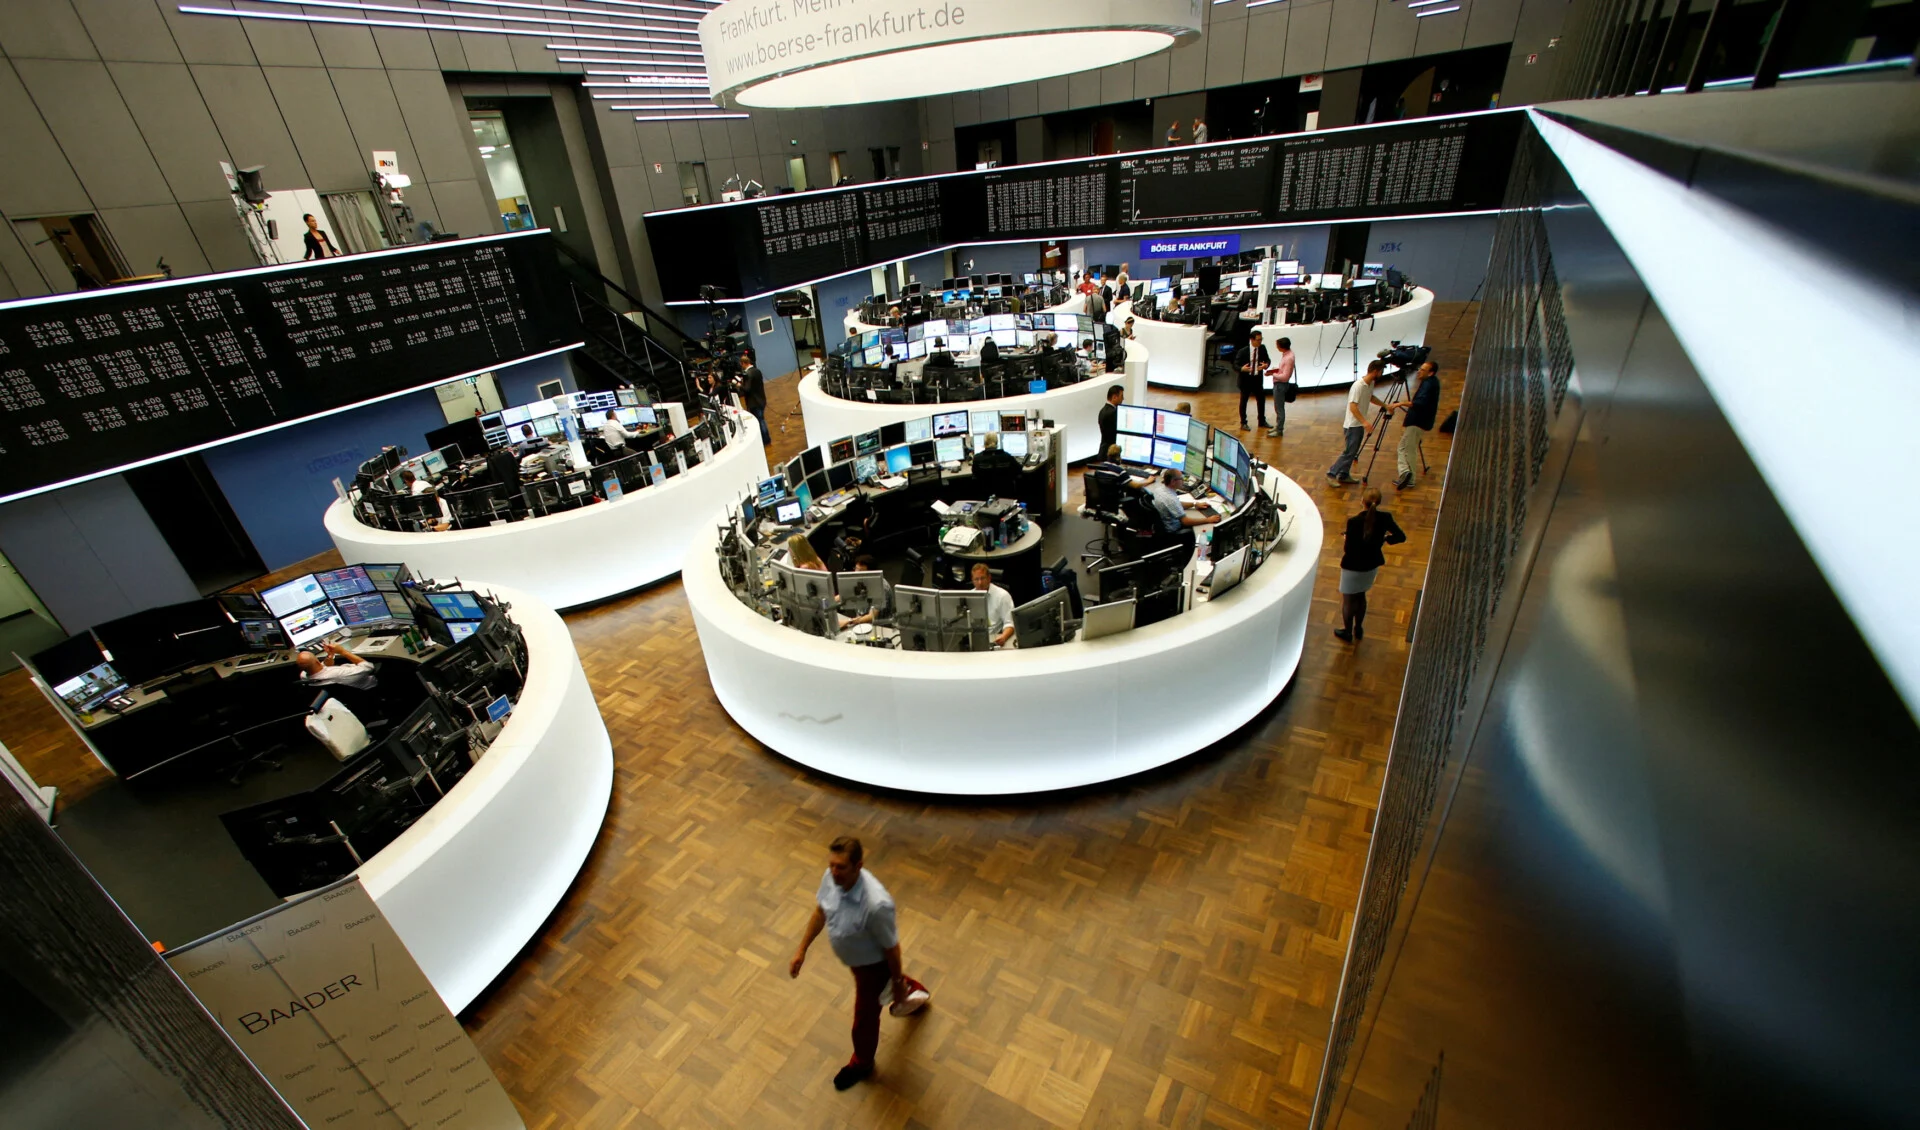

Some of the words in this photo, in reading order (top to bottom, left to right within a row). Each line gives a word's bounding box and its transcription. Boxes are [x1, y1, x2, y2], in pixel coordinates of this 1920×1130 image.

[720, 8, 787, 44] Frankfurt.
[726, 2, 965, 75] www.boerse-frankfurt.de
[1145, 158, 1171, 167] Deutsche
[1241, 146, 1270, 155] 09:27:00
[1150, 243, 1177, 253] BÖRSE
[1178, 241, 1228, 251] FRANKFURT
[262, 277, 308, 288] Technology
[188, 290, 215, 300] 09:26
[218, 288, 233, 296] Uhr
[272, 299, 296, 308] Basic
[298, 292, 337, 303] Resources
[288, 325, 339, 339] Construction
[296, 345, 335, 357] Utilities
[323, 885, 356, 902] BAADER
[287, 919, 321, 937] BAADER
[344, 913, 376, 930] BAADER
[226, 925, 263, 943] BAADER
[188, 960, 225, 978] BAADER
[251, 954, 286, 971] BAADER
[238, 974, 363, 1035] BAADER
[368, 1023, 398, 1042] BAADER
